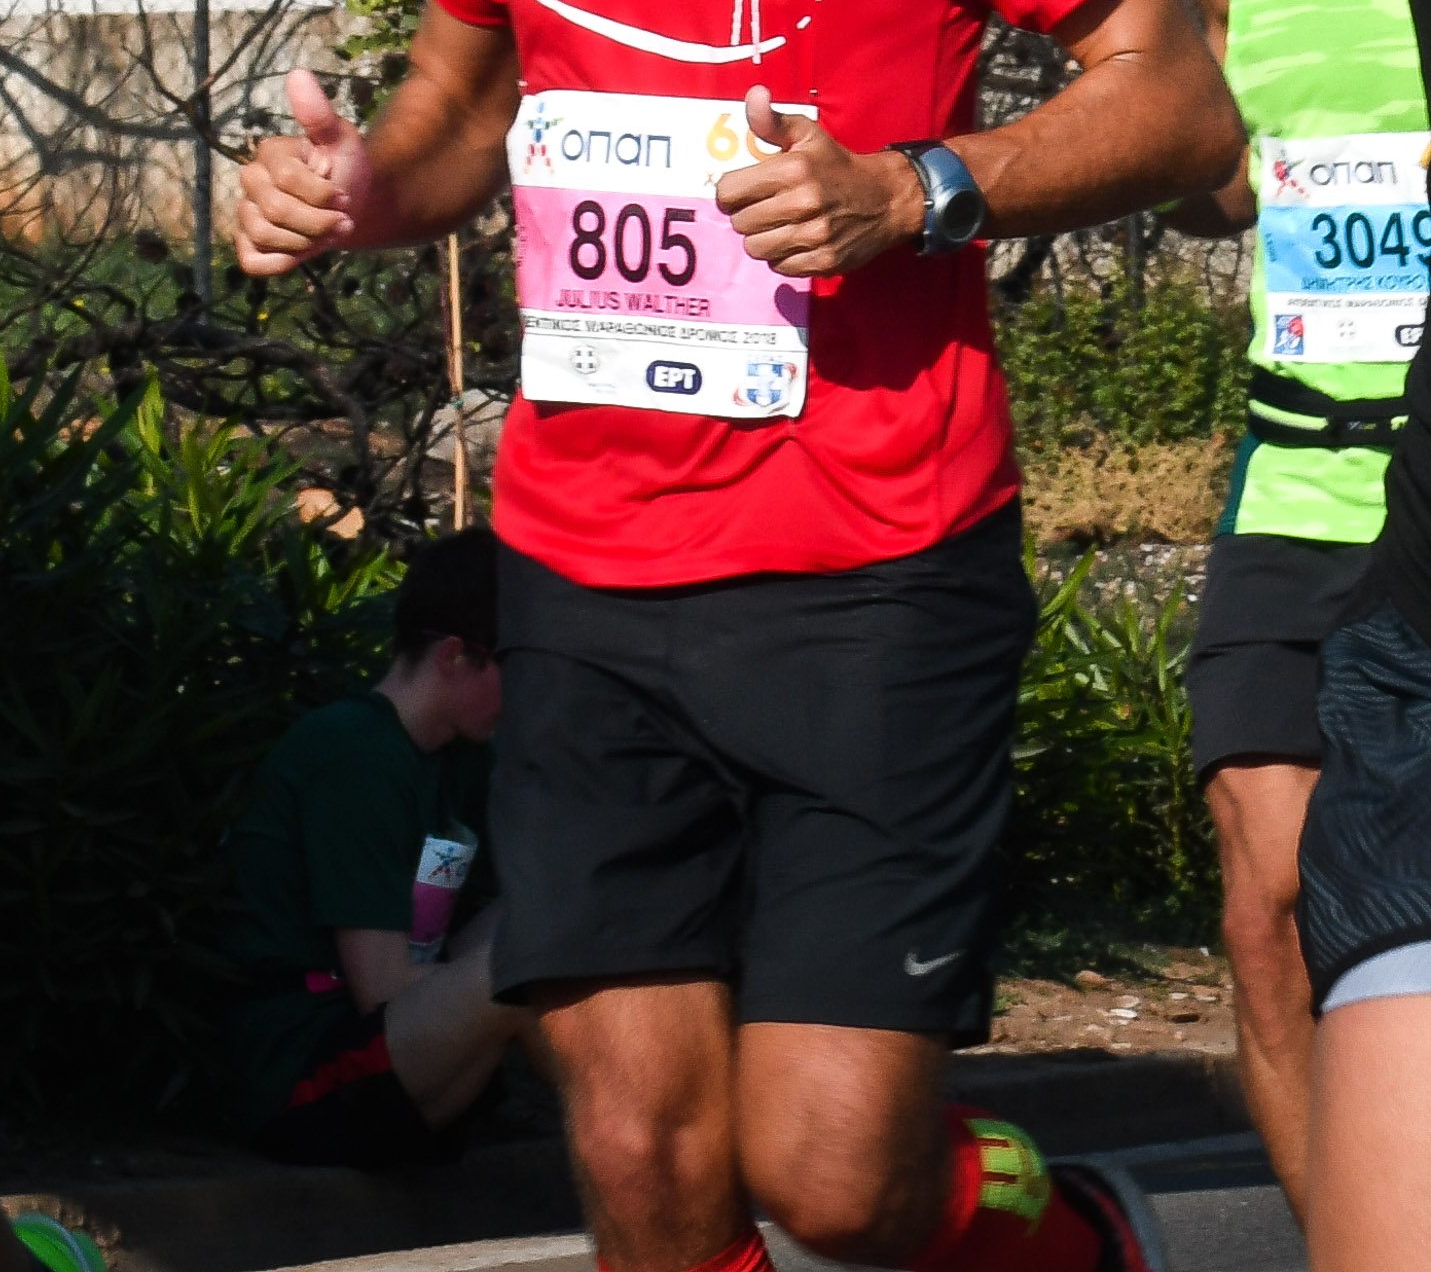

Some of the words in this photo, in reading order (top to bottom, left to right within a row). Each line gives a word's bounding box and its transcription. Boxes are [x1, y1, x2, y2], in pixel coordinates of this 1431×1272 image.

[569, 200, 696, 287] 805
[557, 289, 619, 310] JULIUS
[624, 291, 711, 317] WALTHER
